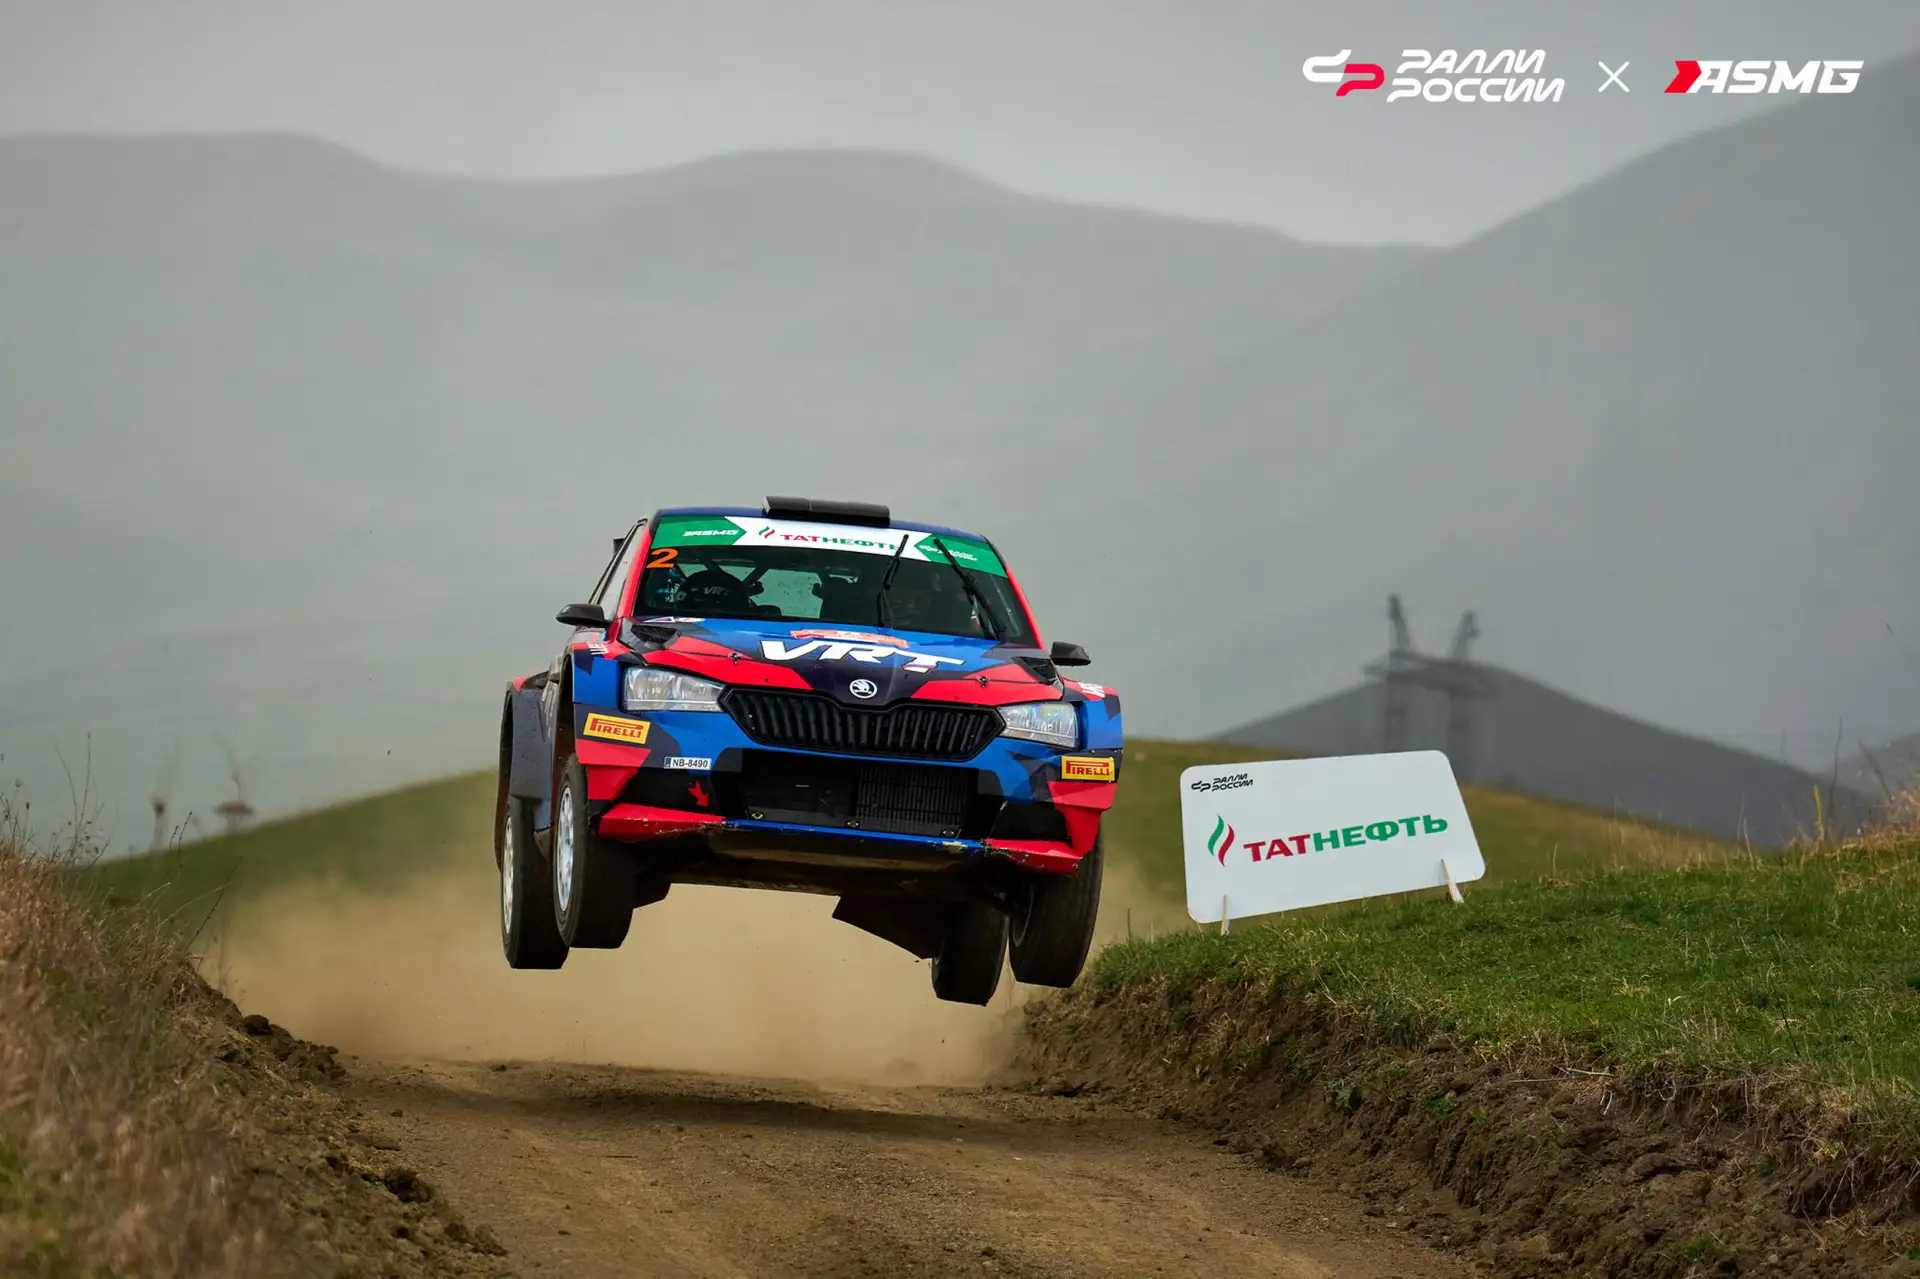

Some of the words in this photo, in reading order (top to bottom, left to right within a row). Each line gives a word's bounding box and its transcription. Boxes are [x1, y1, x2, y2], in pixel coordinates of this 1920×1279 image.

[645, 548, 678, 569] 2
[760, 640, 966, 673] VRT
[589, 717, 644, 739] PIRELLI
[672, 758, 708, 768] NB-8490
[1065, 760, 1110, 776] PIRELLI
[1243, 814, 1449, 862] ТАТНЕФТЬ
